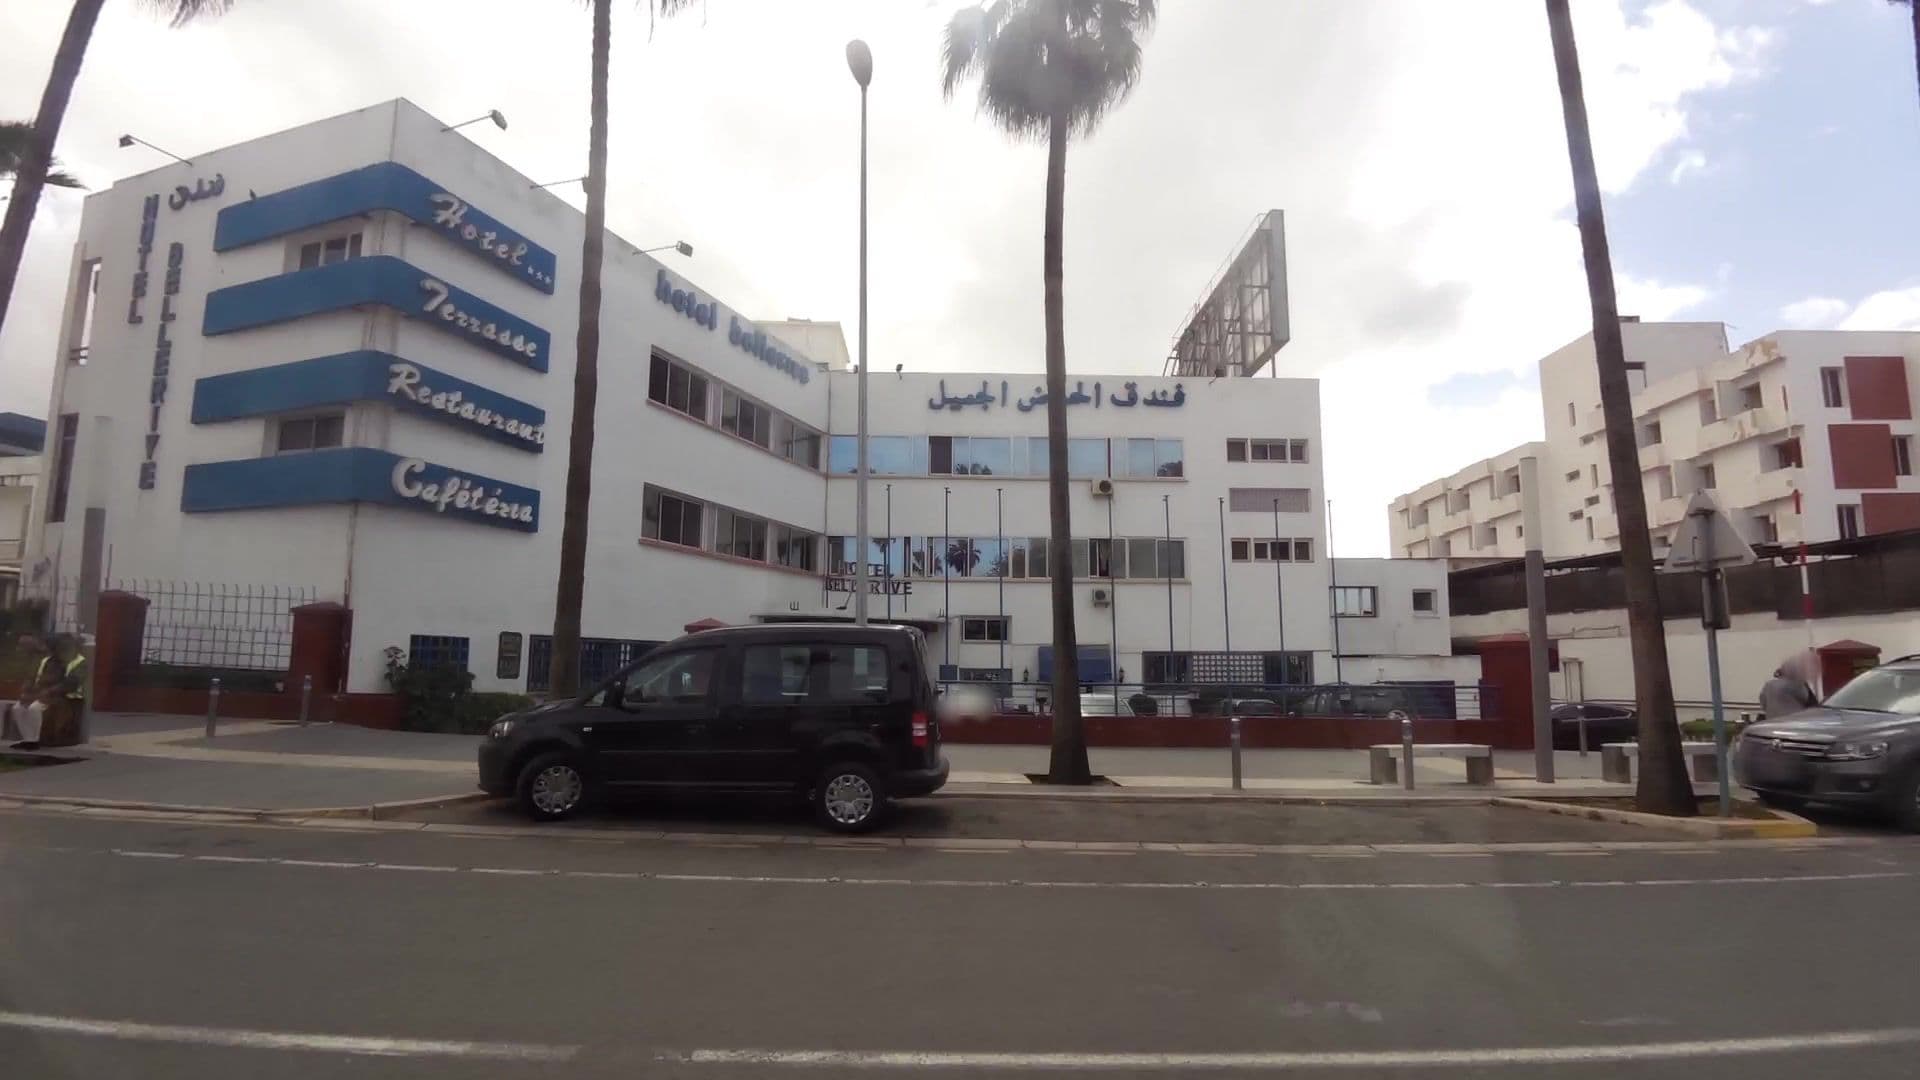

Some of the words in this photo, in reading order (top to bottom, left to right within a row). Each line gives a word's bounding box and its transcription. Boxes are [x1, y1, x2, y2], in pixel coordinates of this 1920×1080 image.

[127, 193, 160, 324] HOTEL
[430, 192, 528, 267] Hotel
[420, 278, 537, 358] Terrasse
[655, 268, 718, 332] hotel
[138, 242, 185, 490] BELLERIVE
[928, 379, 1008, 412] الجميل
[1016, 380, 1102, 413] الحض
[1109, 381, 1186, 408] فندق
[387, 363, 546, 444] Restaurant
[825, 576, 913, 596] BELLRIVE
